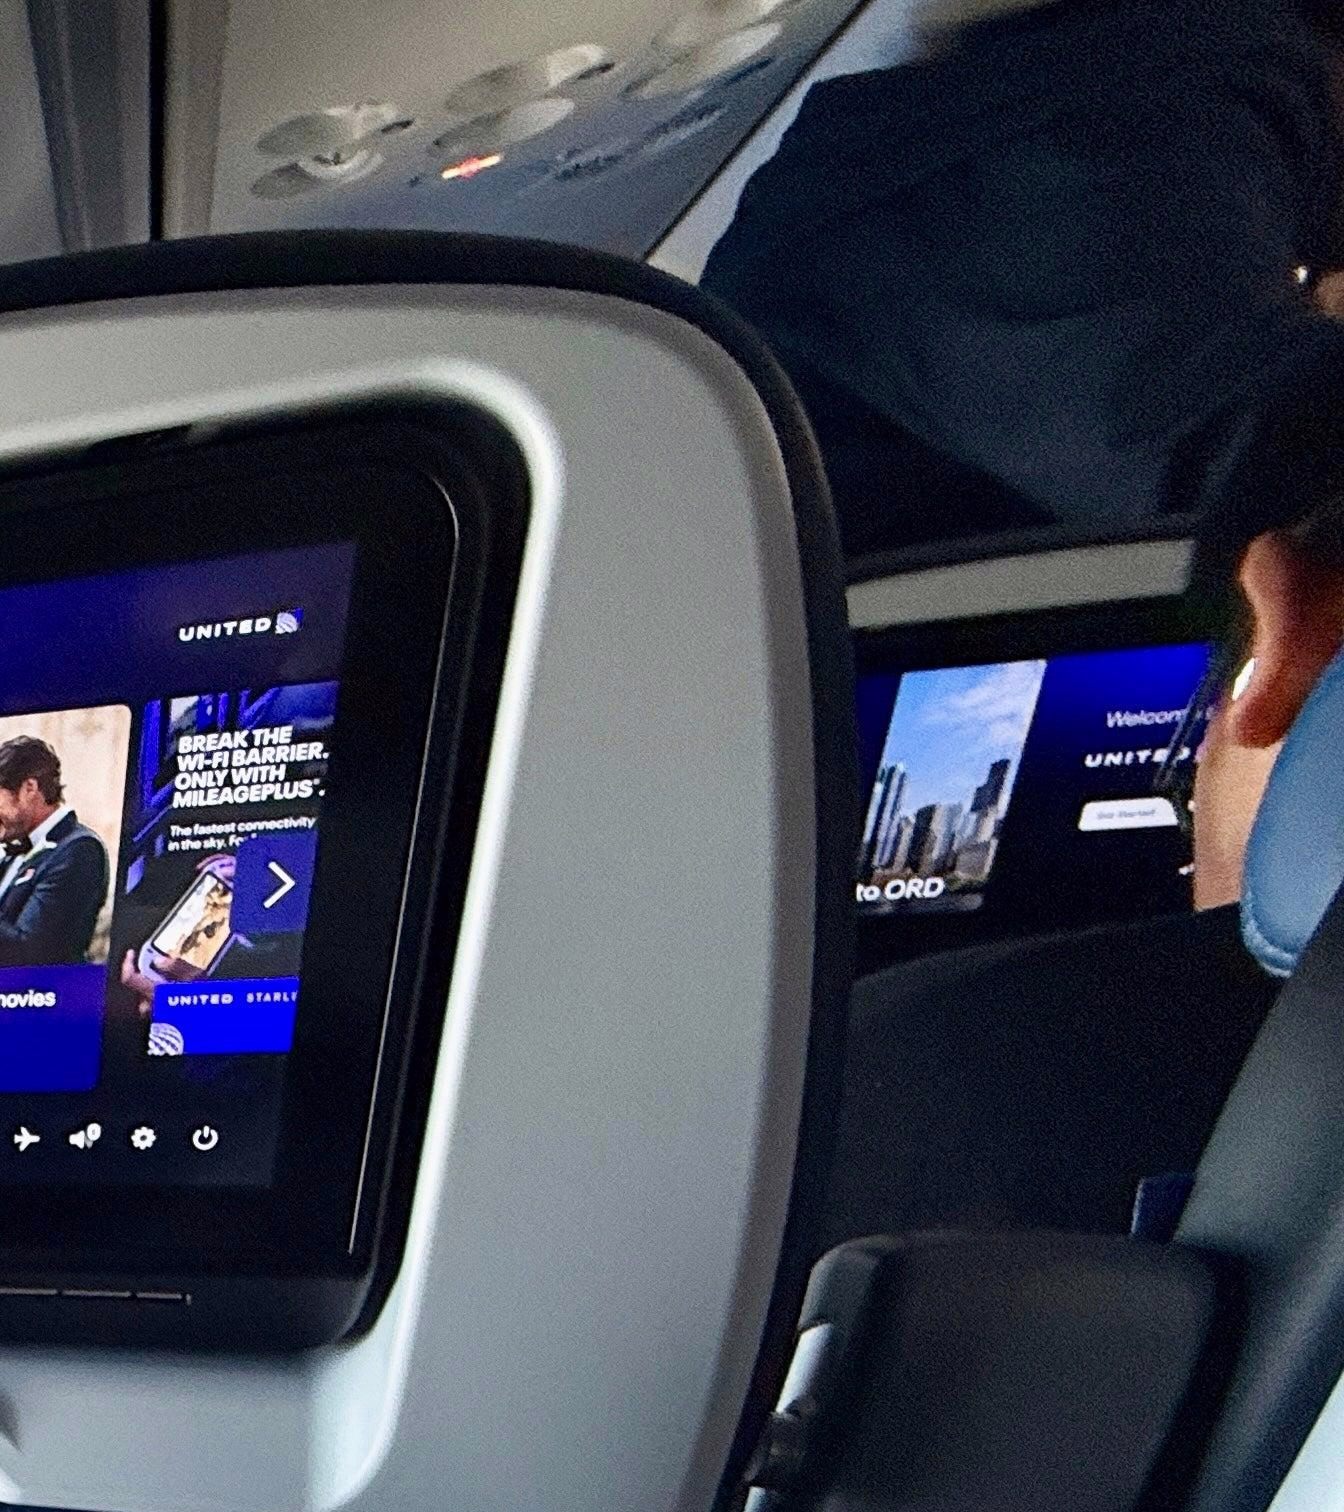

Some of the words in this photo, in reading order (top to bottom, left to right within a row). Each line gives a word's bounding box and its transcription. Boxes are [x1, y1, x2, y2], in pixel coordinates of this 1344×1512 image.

[179, 617, 272, 641] UNITED
[178, 730, 249, 754] BREAK
[251, 725, 294, 747] THE
[177, 751, 229, 771] WI-FI
[231, 742, 330, 766] BARRIER.
[174, 772, 229, 790] ONLY
[231, 764, 286, 783] WITH
[171, 825, 193, 836] The
[193, 822, 238, 835] fastest
[237, 817, 316, 833] connectivity
[856, 883, 881, 901] to
[884, 876, 945, 900] ORD
[168, 994, 233, 1006] UNITED
